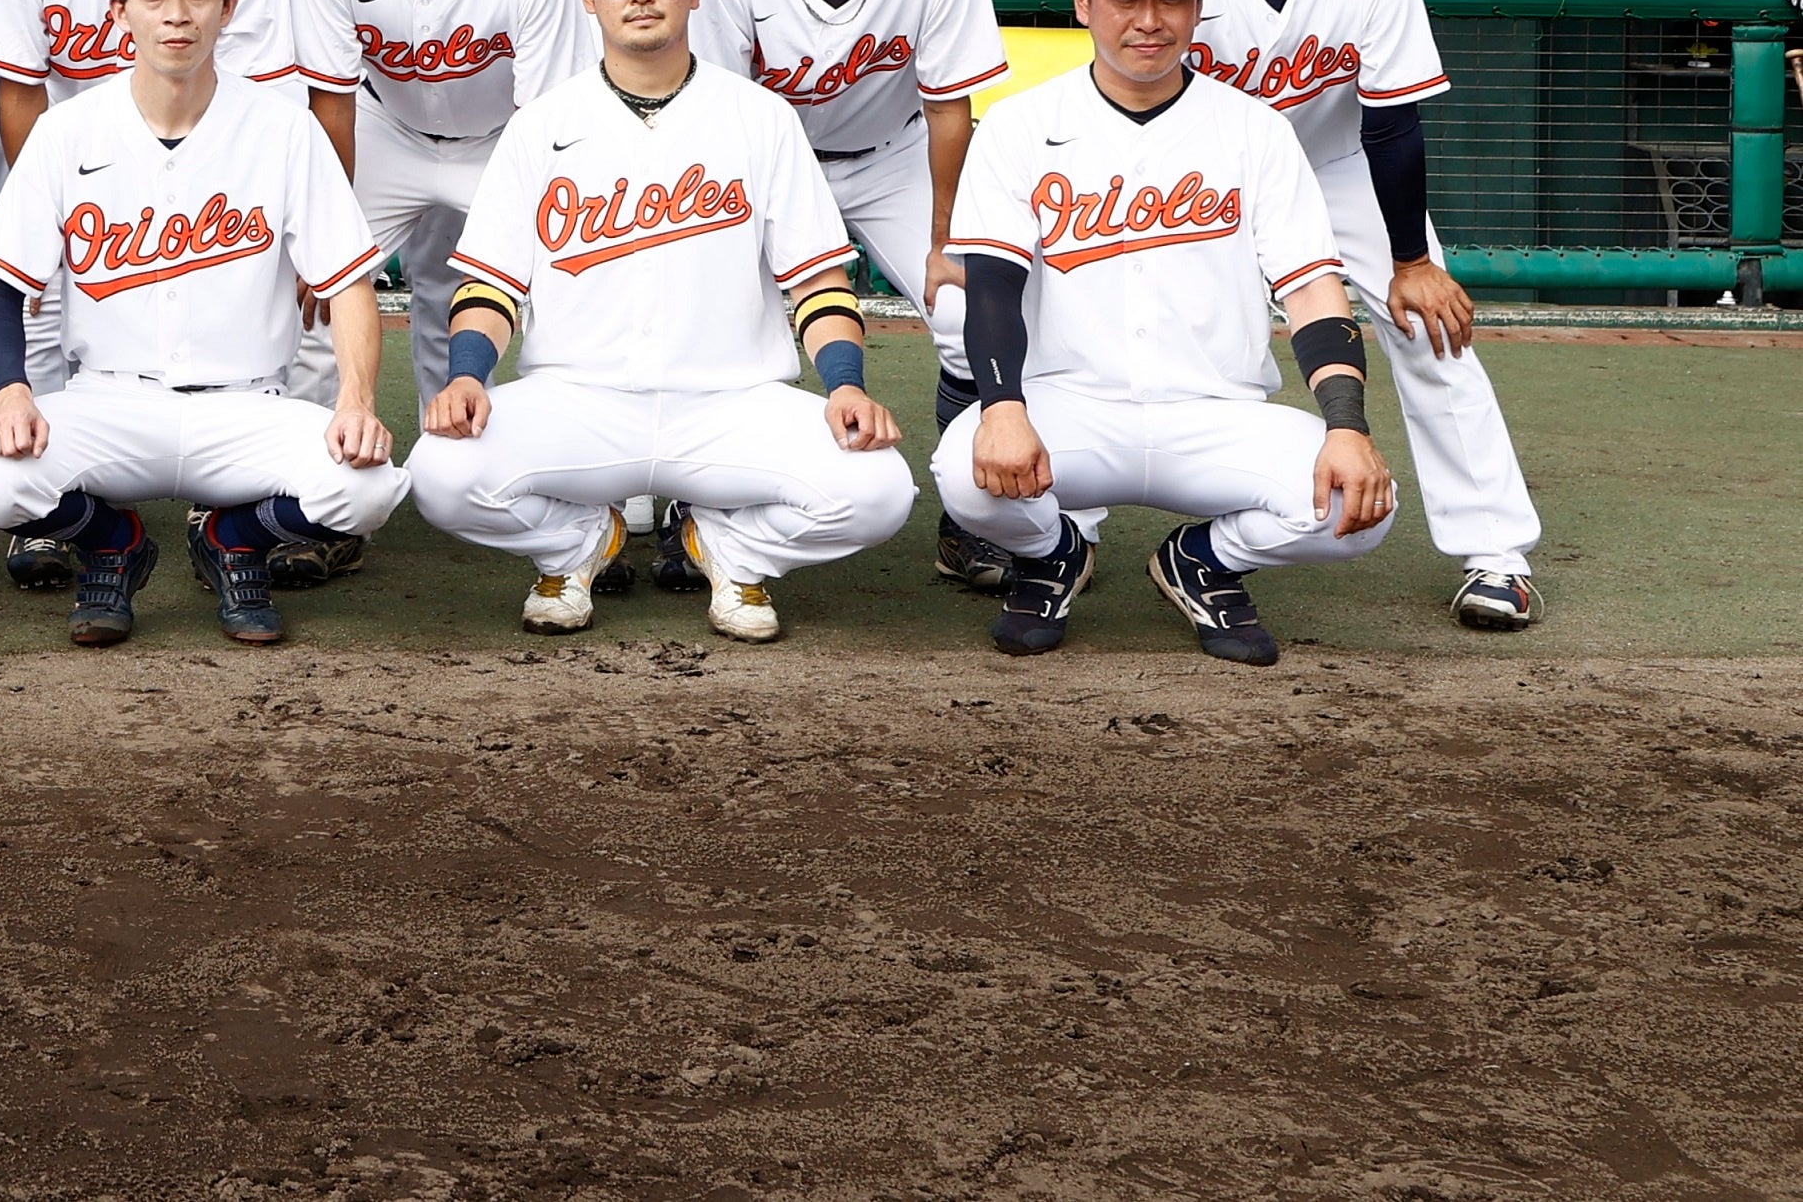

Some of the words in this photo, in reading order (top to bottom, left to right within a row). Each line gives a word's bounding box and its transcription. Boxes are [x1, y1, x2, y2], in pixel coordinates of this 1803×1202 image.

[63, 191, 274, 275] Orioles
[536, 162, 752, 253] Orioles
[1030, 170, 1242, 250] Orioles
